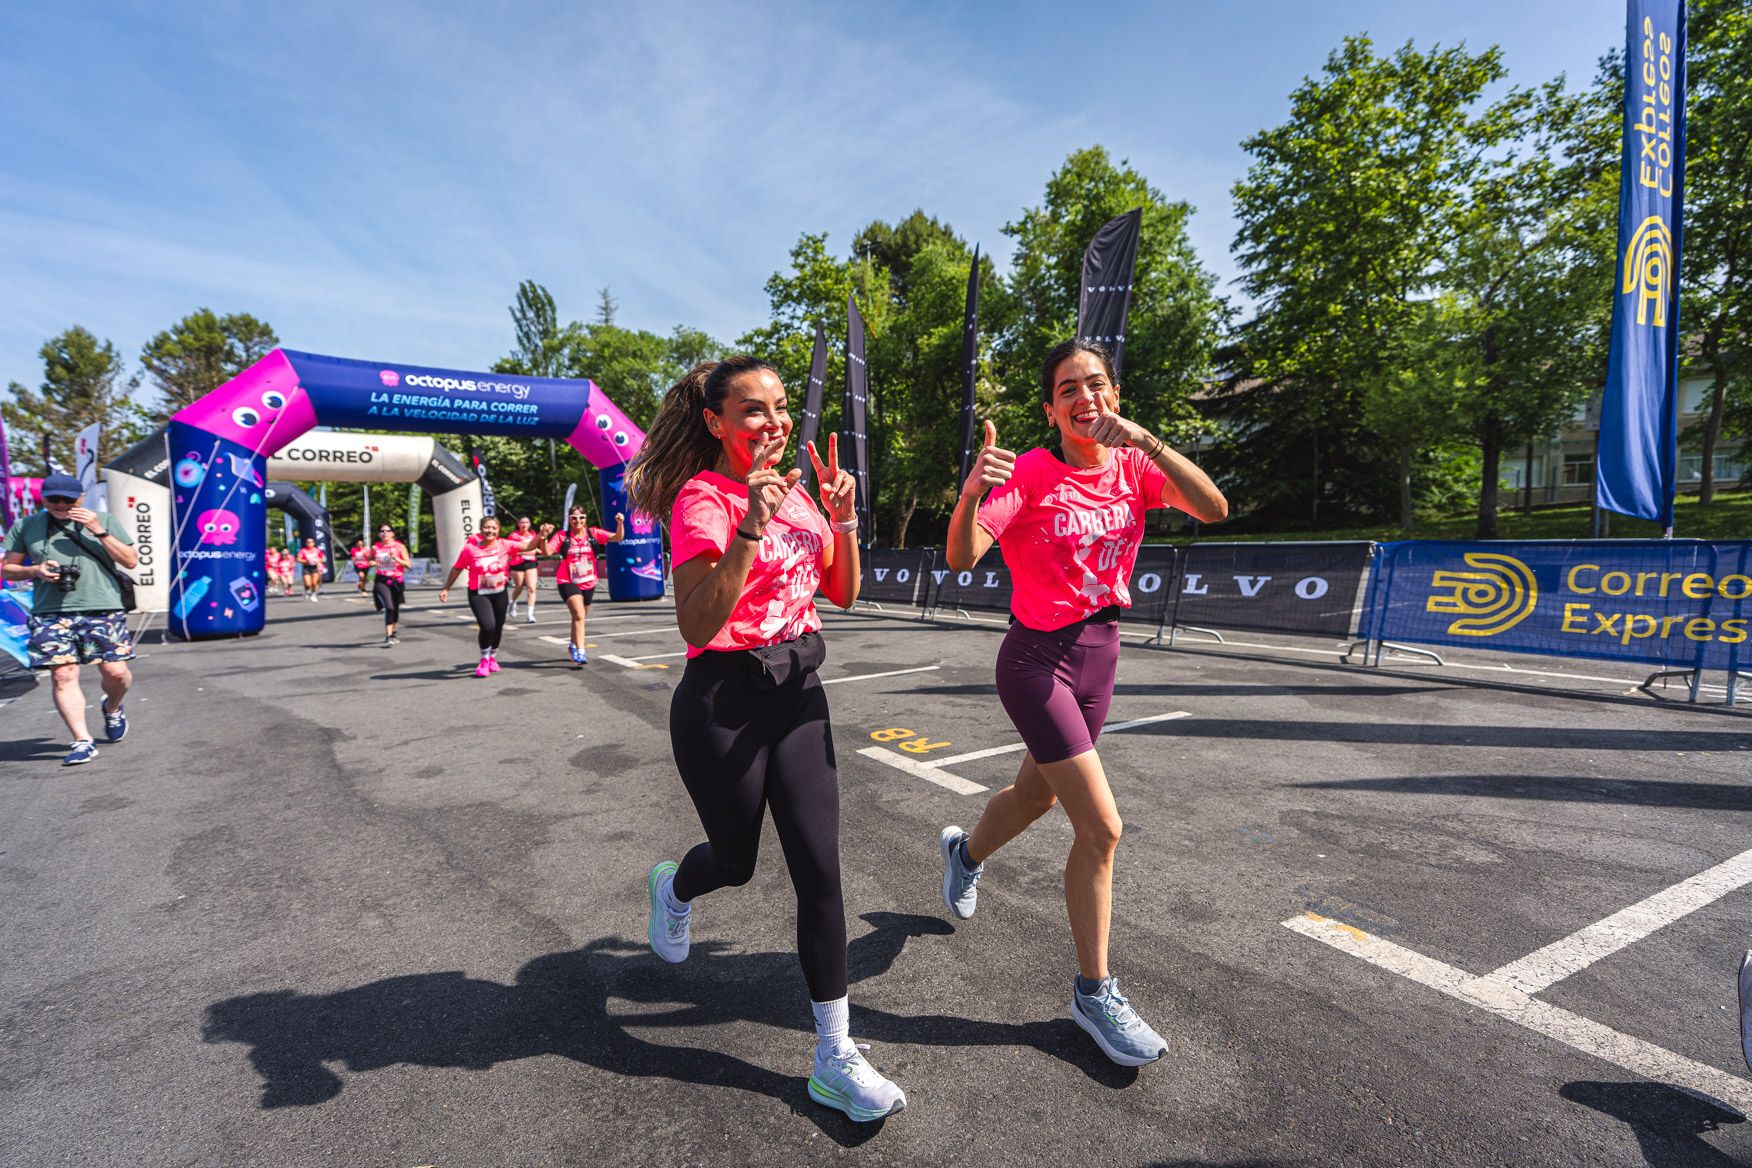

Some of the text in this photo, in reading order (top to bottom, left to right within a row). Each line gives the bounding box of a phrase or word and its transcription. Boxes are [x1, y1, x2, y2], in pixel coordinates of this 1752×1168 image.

[370, 392, 538, 414] LA ENERGÍA PARA CORRER
[367, 406, 540, 426] A LA VELOCIDAD DE LA LUZ
[287, 448, 373, 464] CORREO
[460, 499, 471, 514] EL
[136, 502, 154, 586] EL CORREO
[931, 570, 999, 588] VOL
[1138, 573, 1329, 599] OLVO
[1560, 603, 1752, 646] Expres
